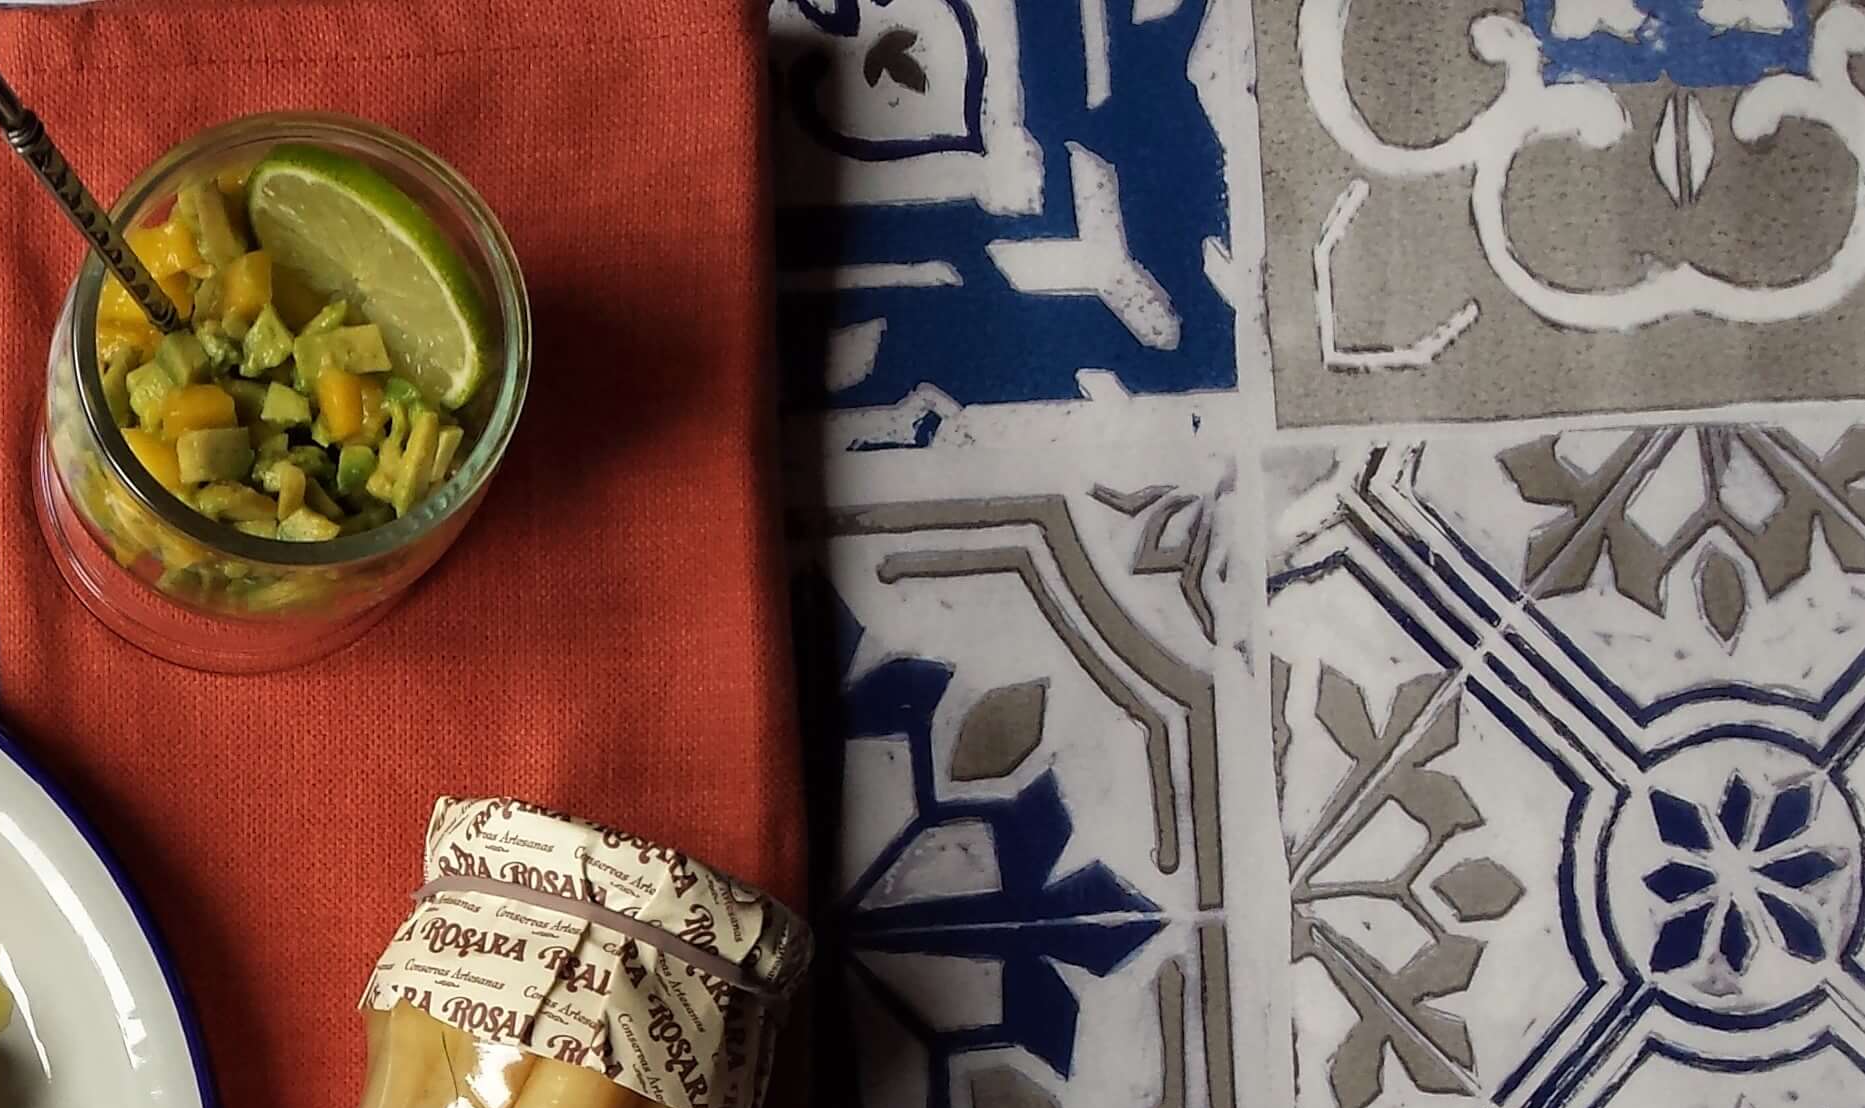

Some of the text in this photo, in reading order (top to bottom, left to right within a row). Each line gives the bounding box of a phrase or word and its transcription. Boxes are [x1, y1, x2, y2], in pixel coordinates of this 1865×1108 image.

[496, 905, 549, 930] Conservas
[420, 916, 528, 962] ROSARA
[404, 958, 506, 991] Conservas Artesanas
[617, 1012, 652, 1074] Conservas
